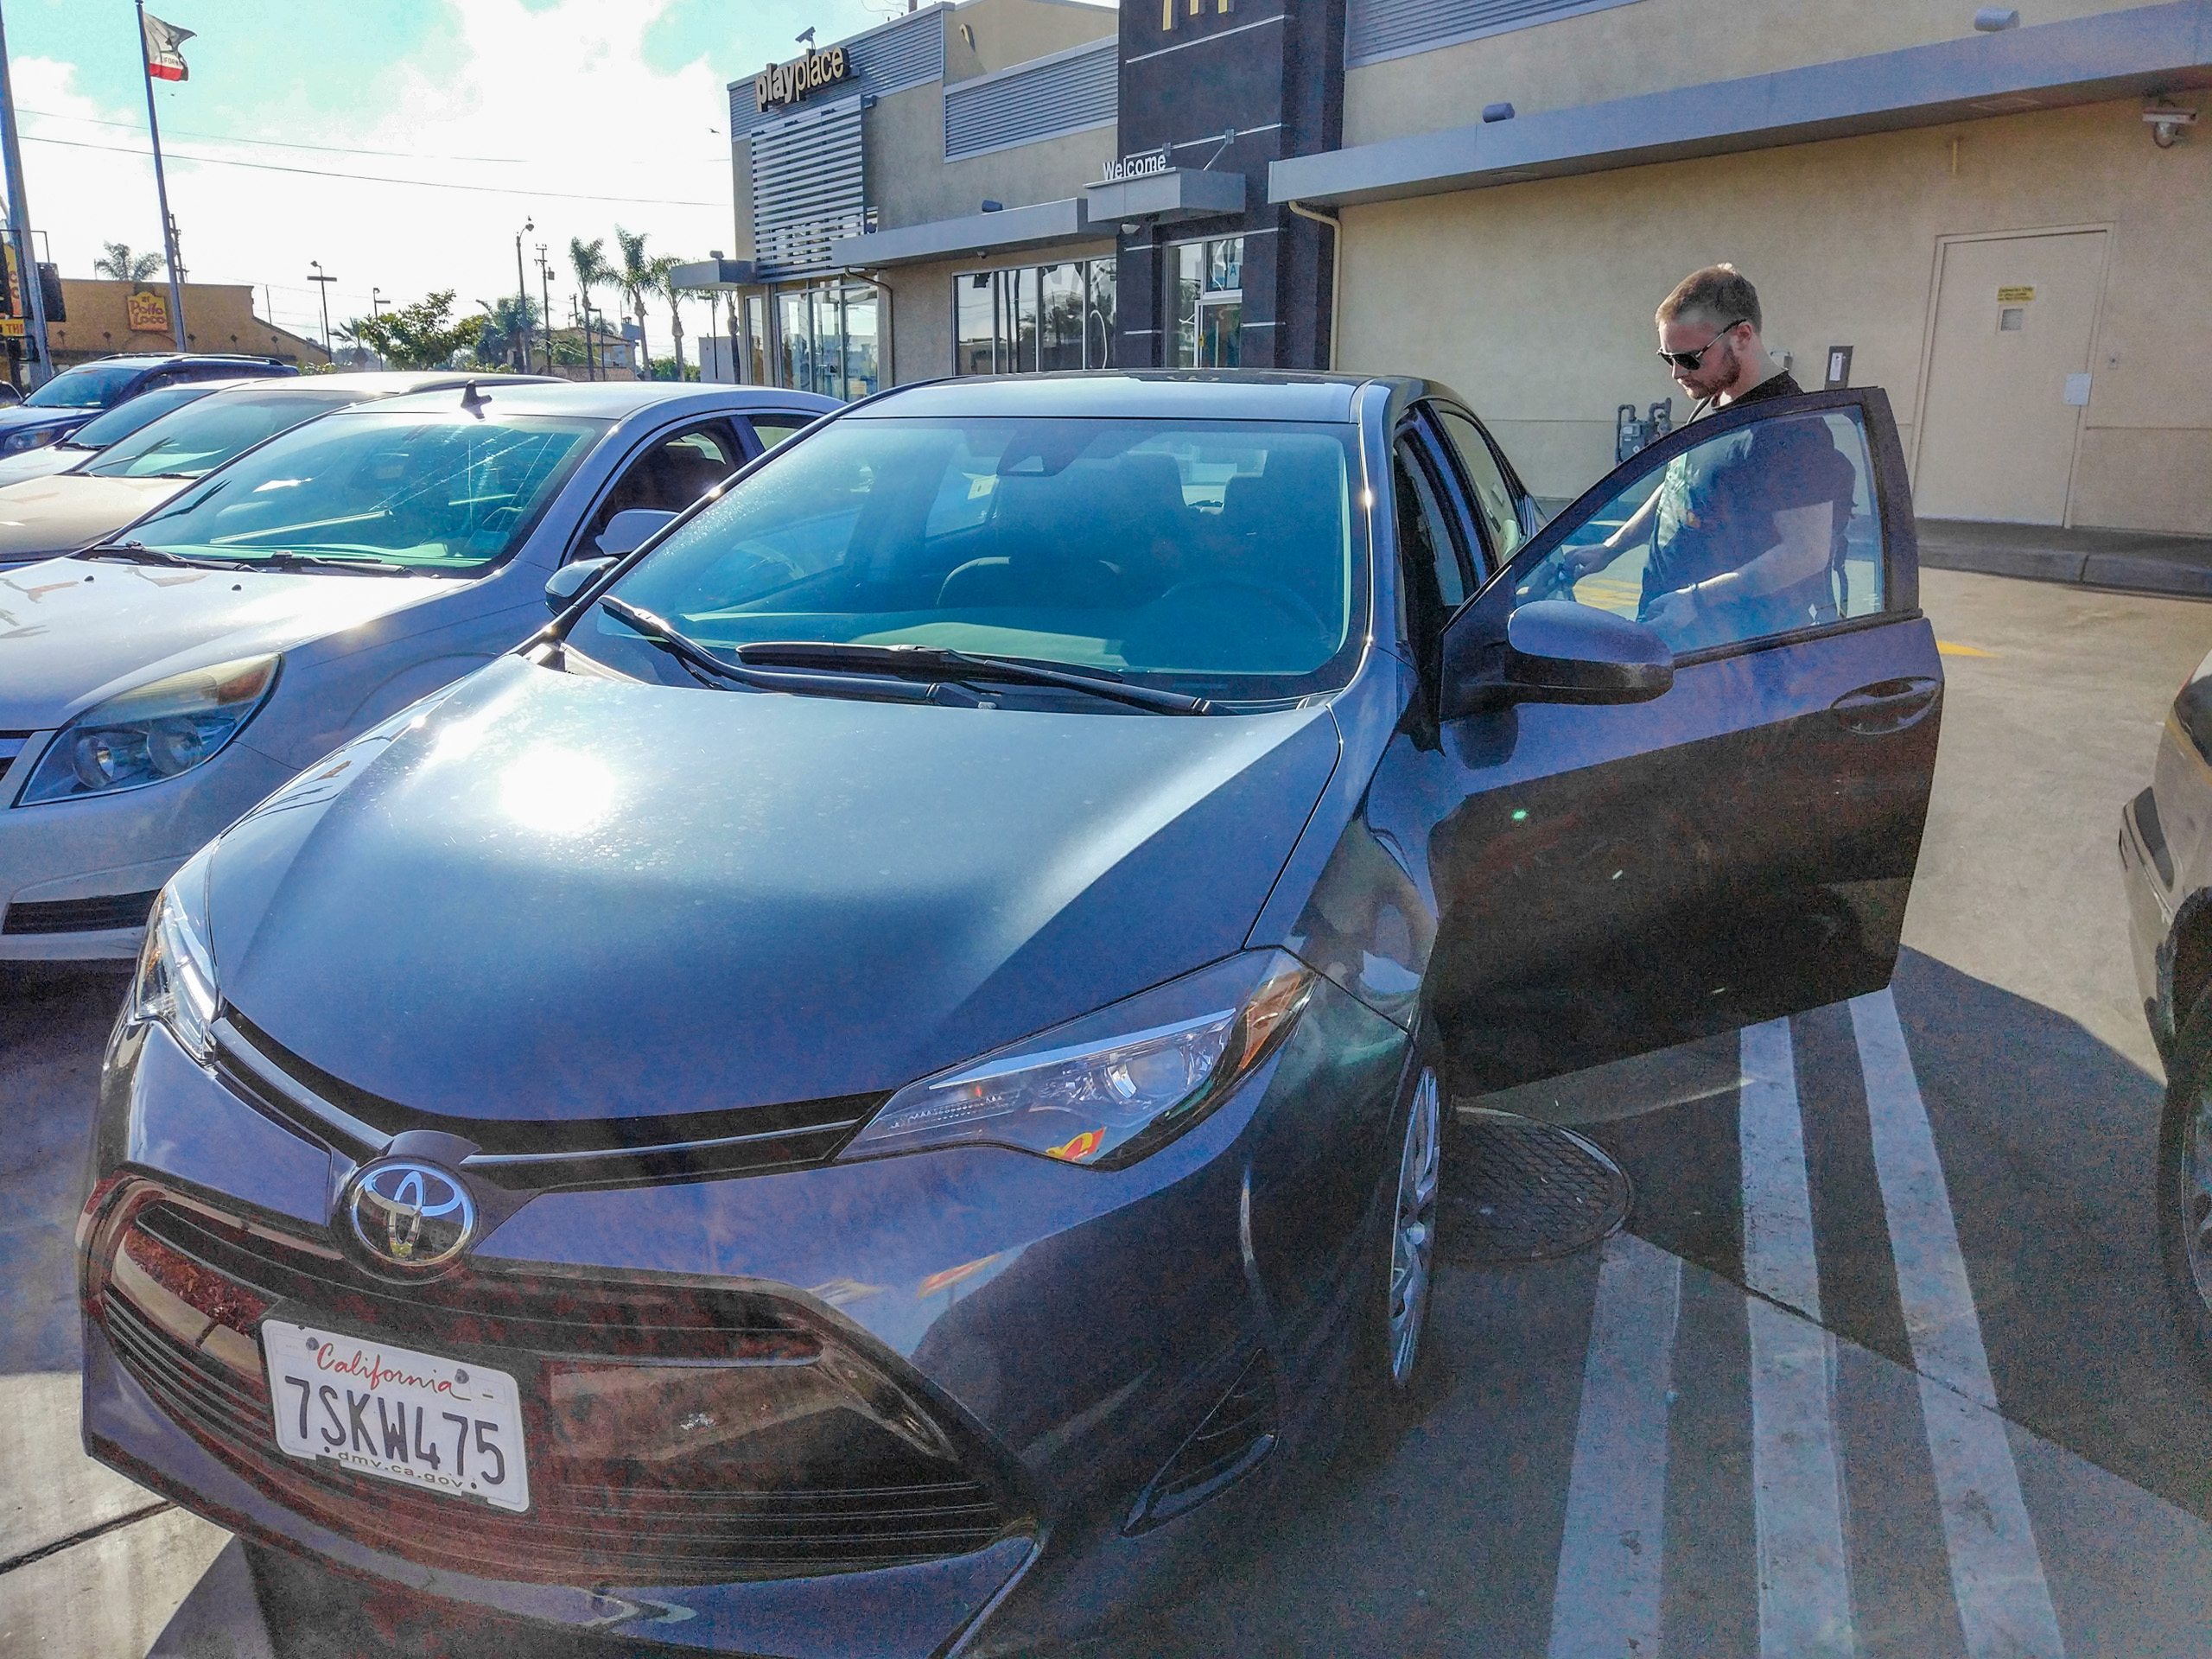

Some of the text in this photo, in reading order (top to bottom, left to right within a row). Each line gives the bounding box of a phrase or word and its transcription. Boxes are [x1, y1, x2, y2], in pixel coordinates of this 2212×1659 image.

[755, 46, 844, 113] playplace
[1103, 154, 1166, 181] Welcome
[1230, 265, 1236, 276] A
[130, 300, 164, 315] Pollo
[134, 312, 166, 326] Loco
[316, 1342, 472, 1402] California
[284, 1375, 505, 1485] 7SKW475
[338, 1451, 464, 1489] dmv.ca.gov
